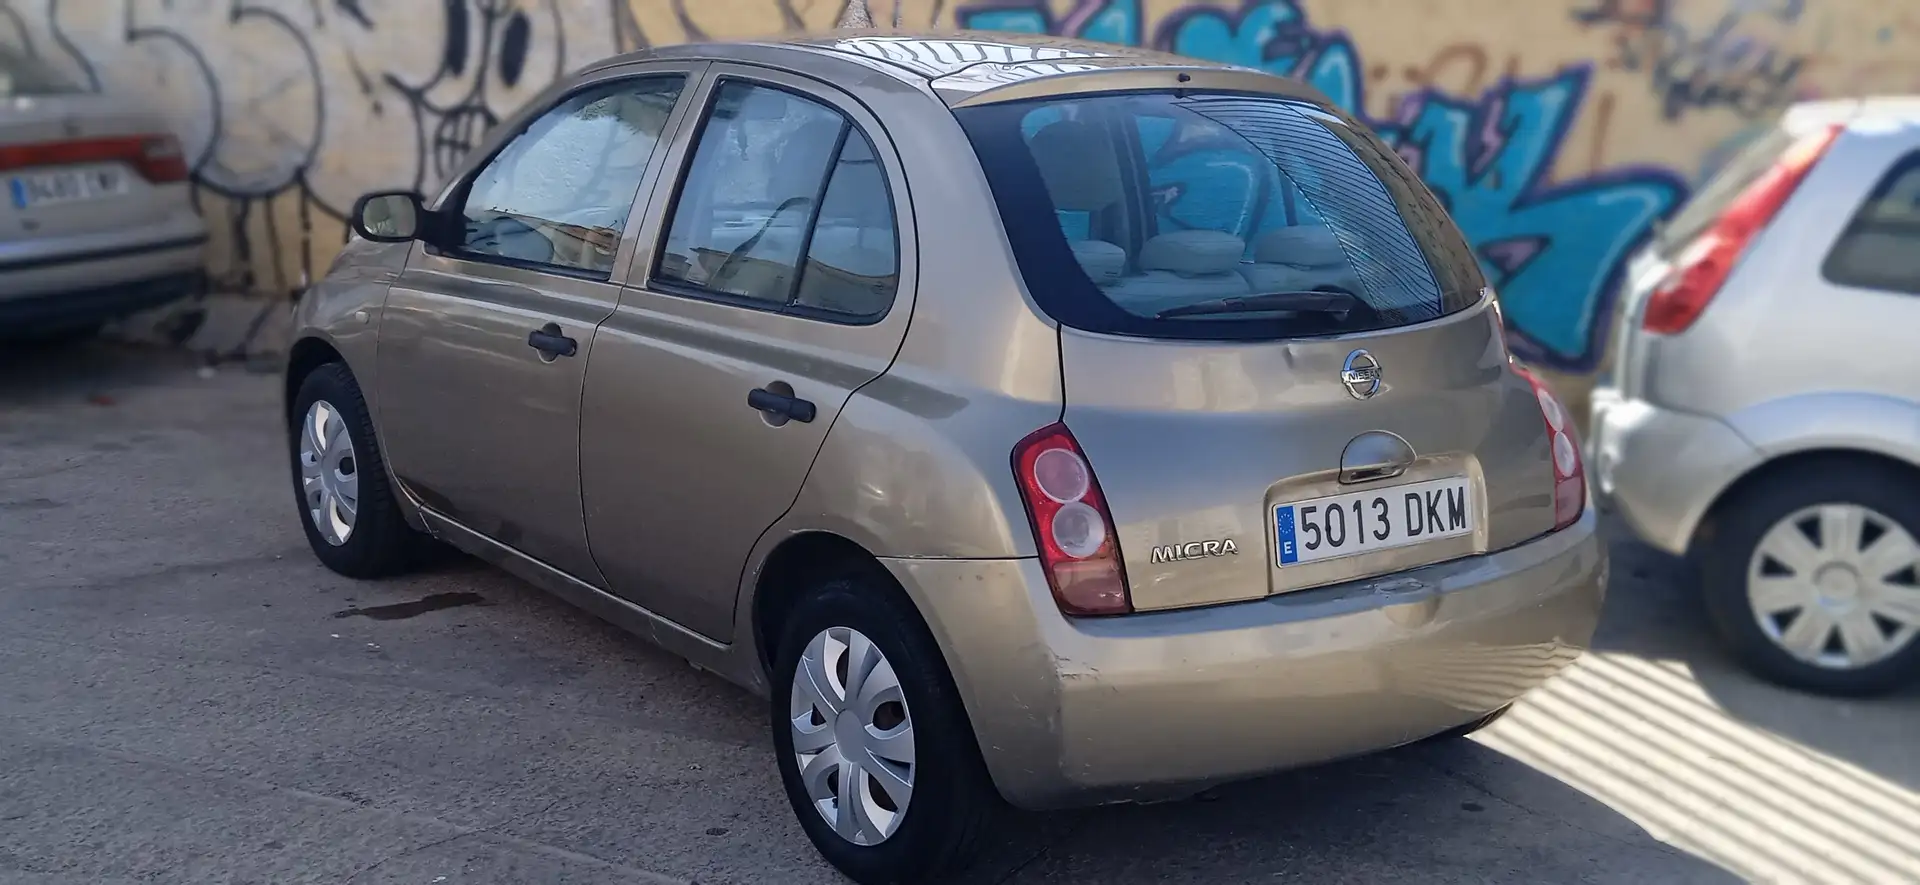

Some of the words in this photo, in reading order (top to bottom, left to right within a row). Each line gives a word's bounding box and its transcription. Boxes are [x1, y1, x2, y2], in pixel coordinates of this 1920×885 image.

[1348, 369, 1380, 381] NISSAN
[1301, 497, 1391, 550] 5013
[1404, 486, 1466, 537] DKM
[1151, 538, 1238, 564] MICRA
[1283, 540, 1293, 555] E
